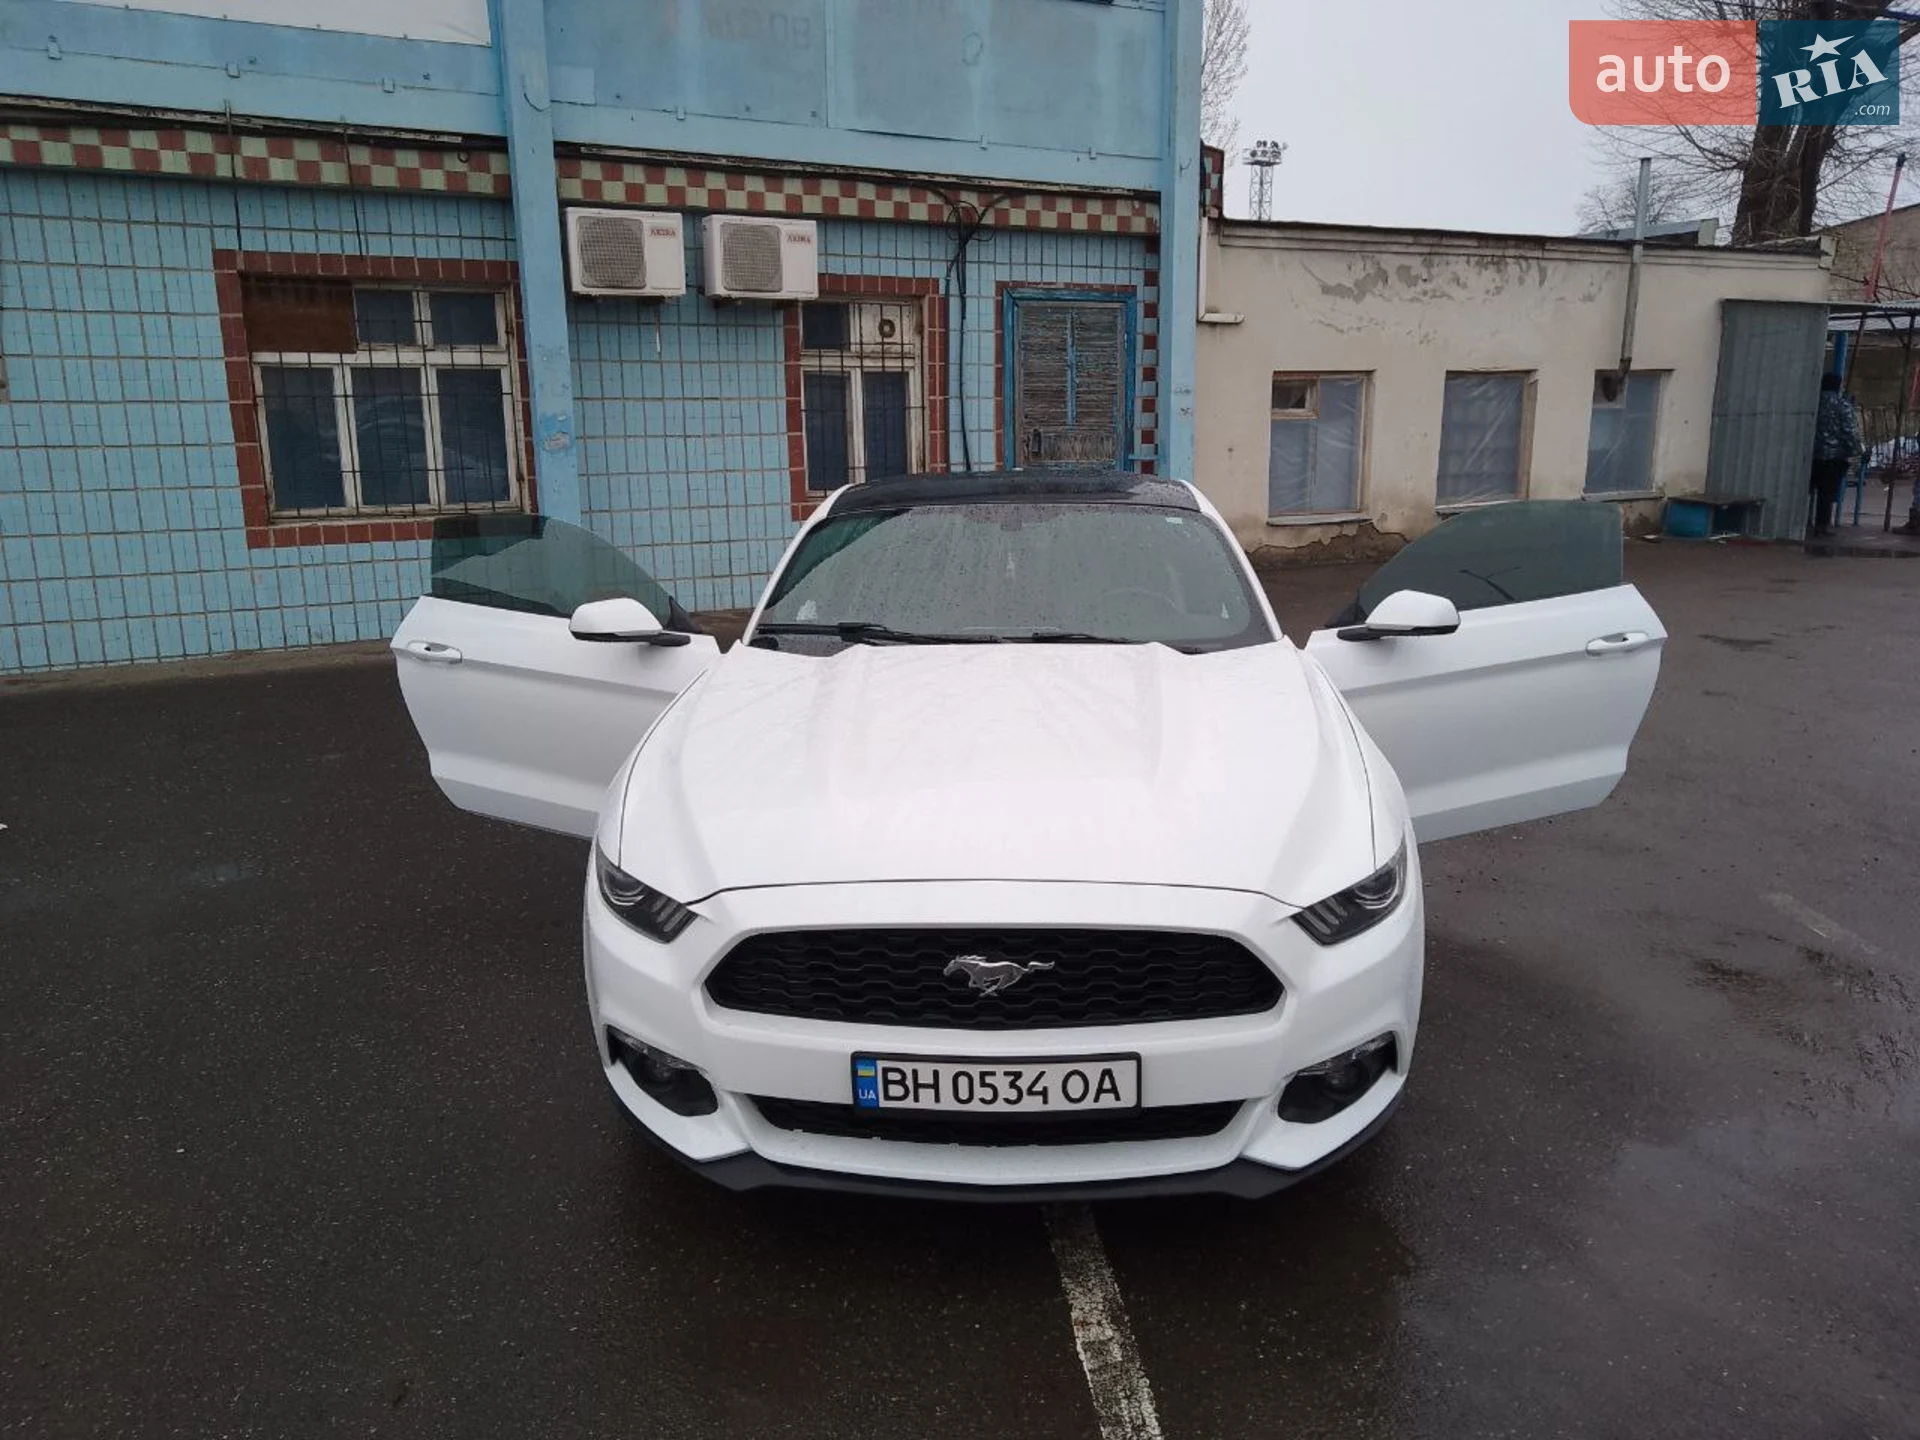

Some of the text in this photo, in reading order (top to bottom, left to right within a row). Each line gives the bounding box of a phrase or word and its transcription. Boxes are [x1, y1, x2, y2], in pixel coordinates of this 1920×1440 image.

[858, 1088, 877, 1100] UA
[881, 1066, 1122, 1105] BH 0534 OA
